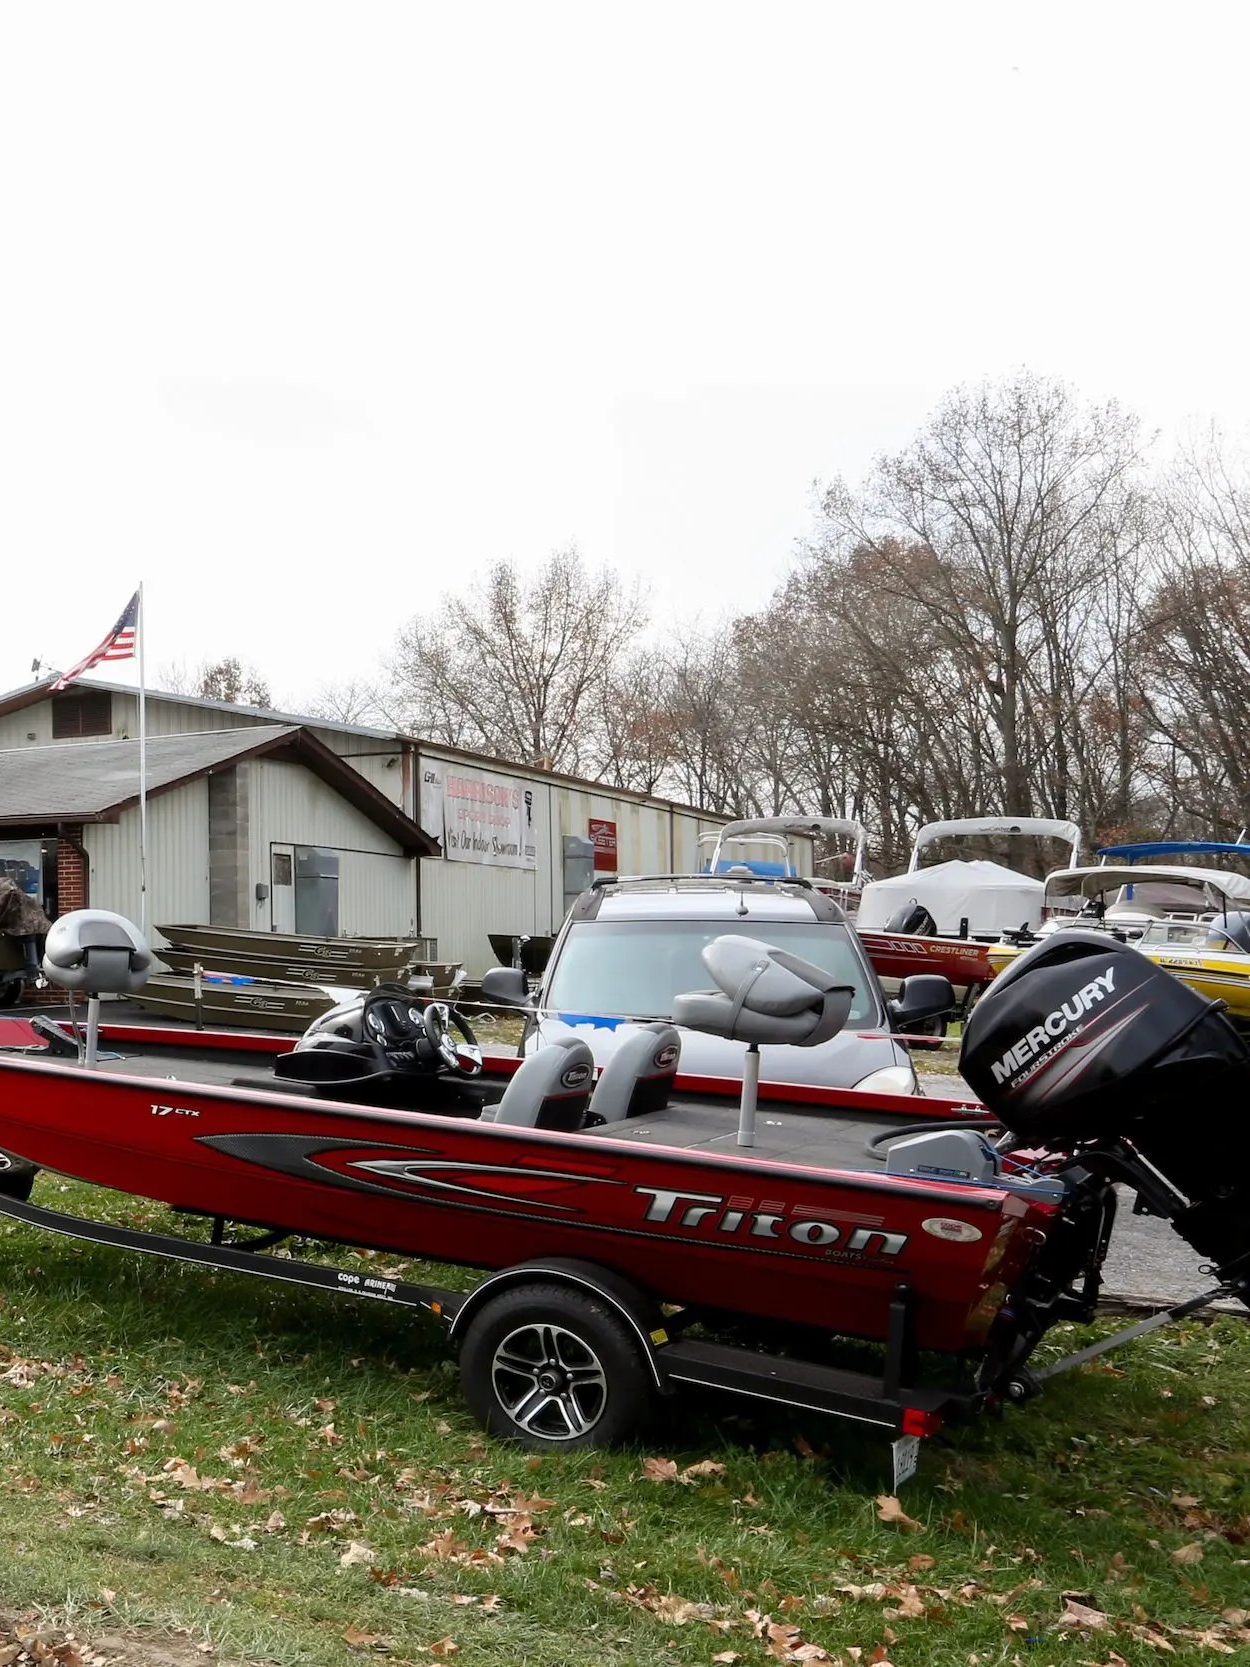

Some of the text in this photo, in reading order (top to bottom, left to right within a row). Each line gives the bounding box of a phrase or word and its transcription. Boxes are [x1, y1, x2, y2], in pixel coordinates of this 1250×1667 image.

[930, 945, 979, 956] CRESTLINER
[990, 966, 1115, 1084] MERCURY
[1011, 1024, 1084, 1088] FOURSTROKE
[150, 1104, 200, 1117] 17 CTX
[634, 1184, 909, 1255] Triton
[825, 1249, 862, 1260] BOATS
